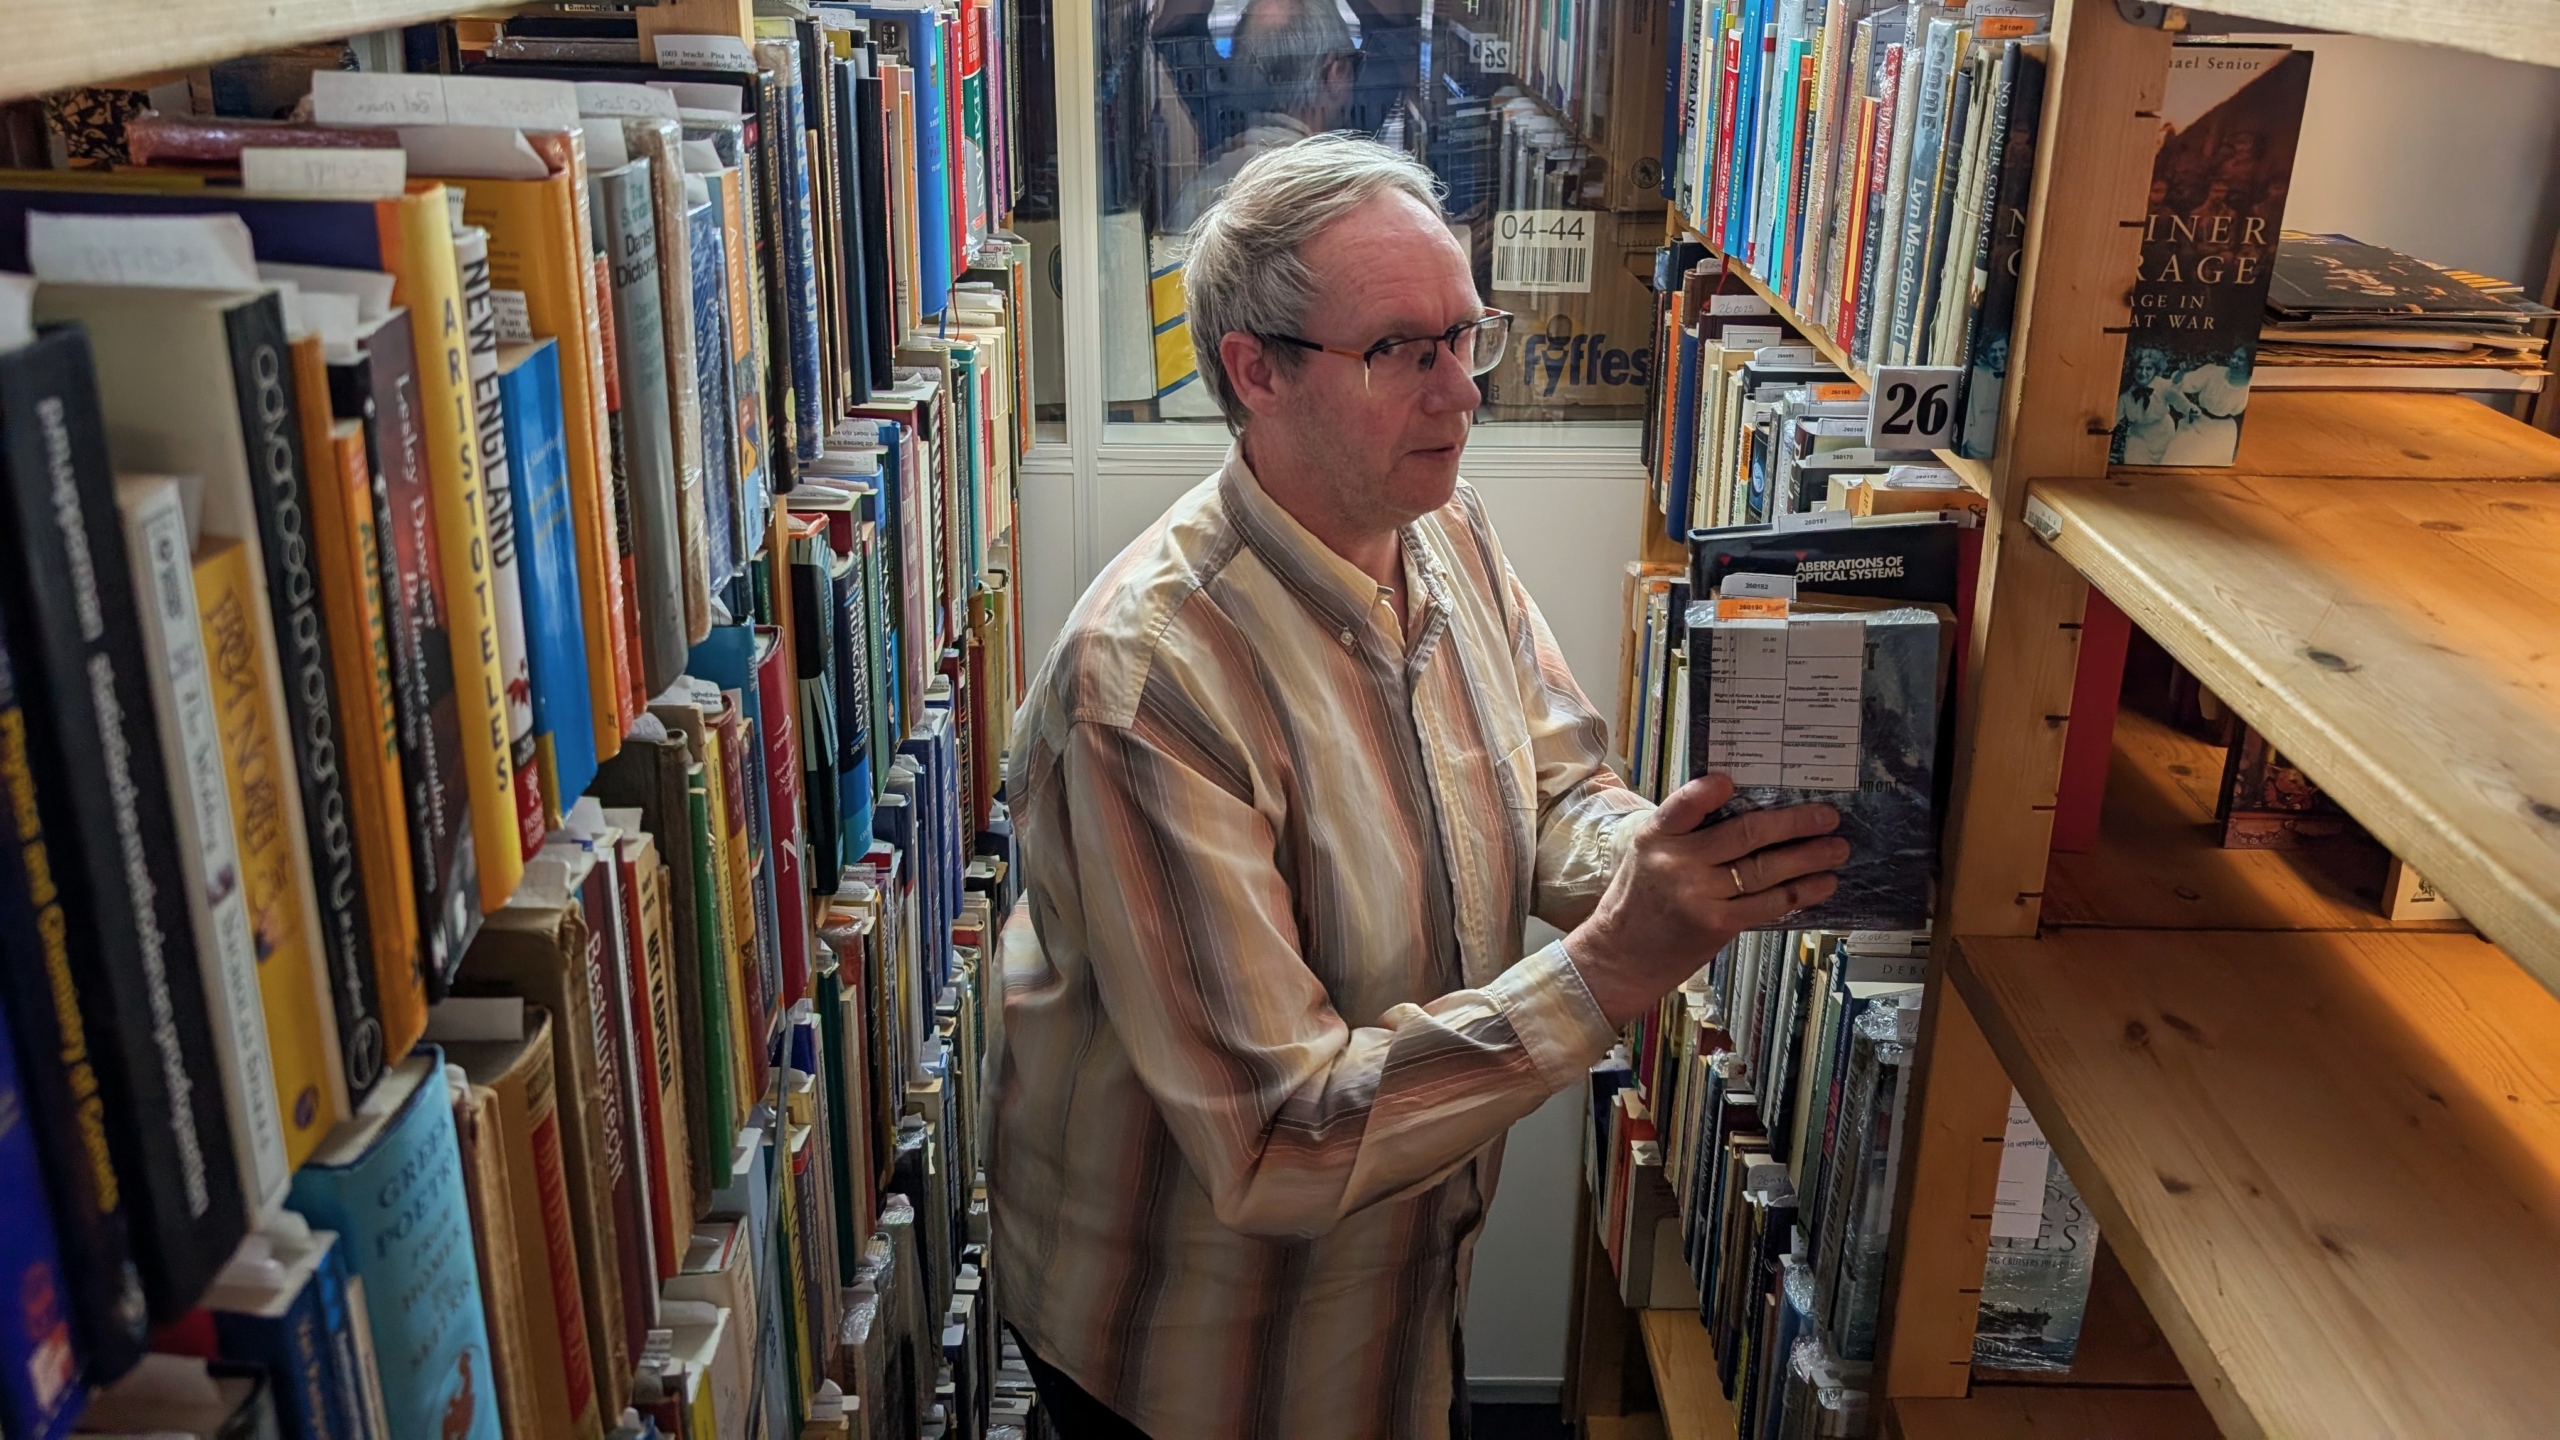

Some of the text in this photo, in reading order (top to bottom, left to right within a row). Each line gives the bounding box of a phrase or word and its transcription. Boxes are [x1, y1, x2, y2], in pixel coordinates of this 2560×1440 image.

[682, 50, 705, 59] bracht
[1687, 3, 1702, 130] NDERGANG
[1809, 27, 1824, 109] Protestantse
[2207, 57, 2261, 71] Senior
[1997, 80, 2012, 105] NO
[973, 77, 985, 208] ITALIAN
[1779, 129, 1791, 202] Onbewust
[1990, 115, 2009, 169] FINER
[1729, 149, 1742, 222] FRANKRIJK
[1797, 163, 1809, 215] Limmen
[1501, 214, 1586, 241] 04-44
[1977, 172, 1999, 260] COURAGE
[2143, 215, 2269, 246] INER
[1894, 177, 1928, 345] Lyn Macdonald
[728, 227, 744, 353] Australia
[1855, 248, 1874, 332] HOLLAND
[2180, 295, 2205, 310] IN
[1962, 316, 1973, 364] MICHAEL
[2168, 315, 2217, 330] WAR
[463, 258, 515, 571] NEW ENGLAND
[1881, 382, 1949, 436] 26
[395, 374, 435, 629] Lesley Downer
[932, 415, 944, 599] HEBREW
[1967, 503, 1988, 518] Se
[443, 298, 511, 793] ARISTOTELES
[1795, 556, 1904, 573] ABERRATIONS OF
[1796, 566, 1905, 583] OPTICAL SYSTEMS
[848, 603, 865, 734] HUNGARIAN
[586, 929, 625, 1192] Bestuursrecht
[1773, 1070, 1788, 1127] ATLANTIC
[1840, 1097, 1855, 1147] BATTLE
